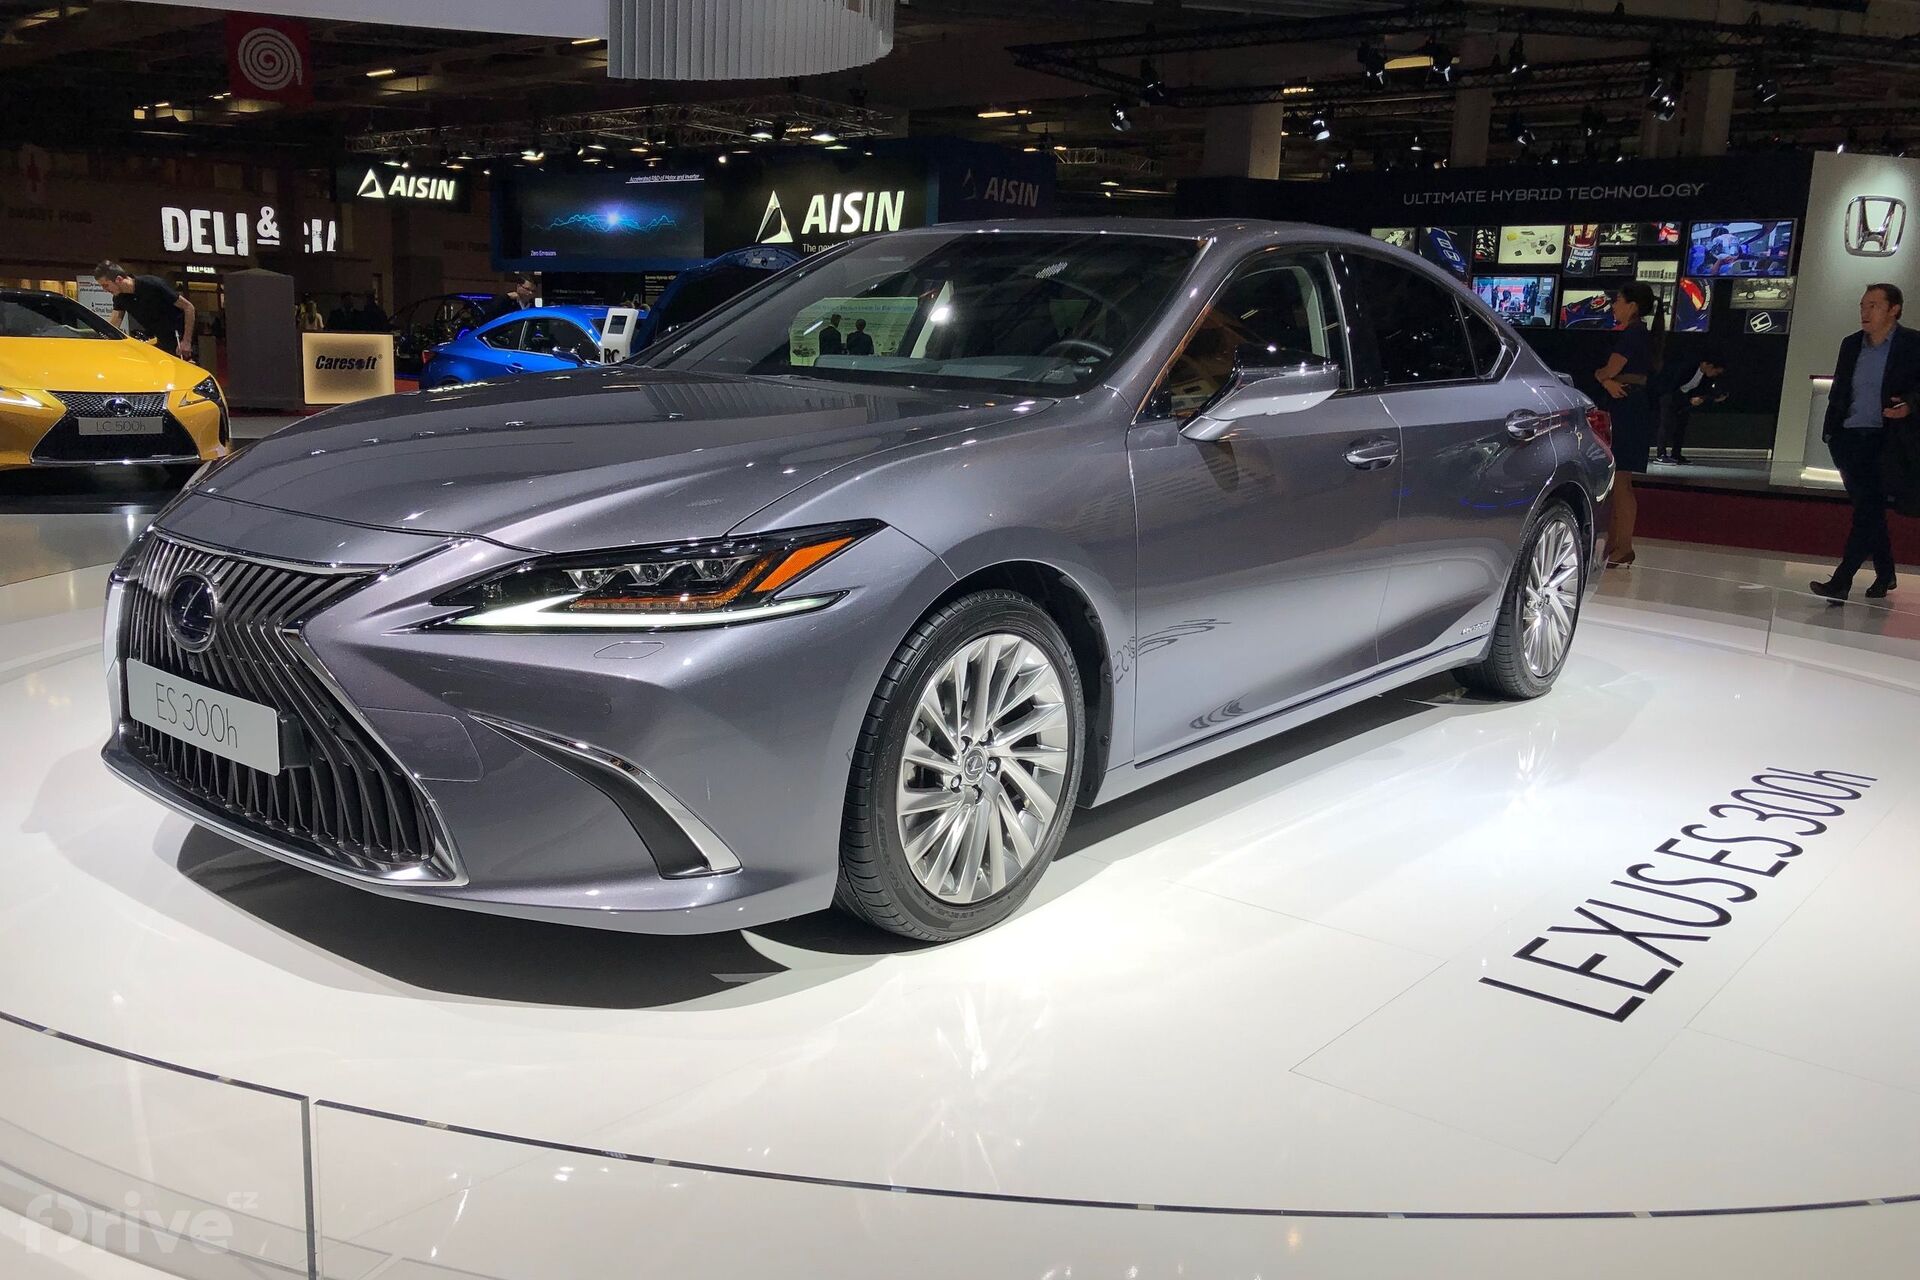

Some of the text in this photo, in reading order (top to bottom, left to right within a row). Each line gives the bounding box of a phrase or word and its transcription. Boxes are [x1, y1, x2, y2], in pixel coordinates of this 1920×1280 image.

[388, 175, 456, 200] AISIN
[983, 176, 1040, 208] AISIN
[1403, 182, 1705, 206] ULTIMATE HYBRID TECHNOLOGY
[801, 190, 905, 235] AISIN
[161, 206, 249, 256] DELI
[256, 205, 280, 246] &
[802, 243, 817, 253] The
[315, 355, 378, 370] Caresoft
[604, 348, 620, 363] RC
[95, 420, 146, 432] LC 500h
[155, 682, 238, 748] ES 300h
[1478, 767, 1878, 1022] LEXUS ES 300h
